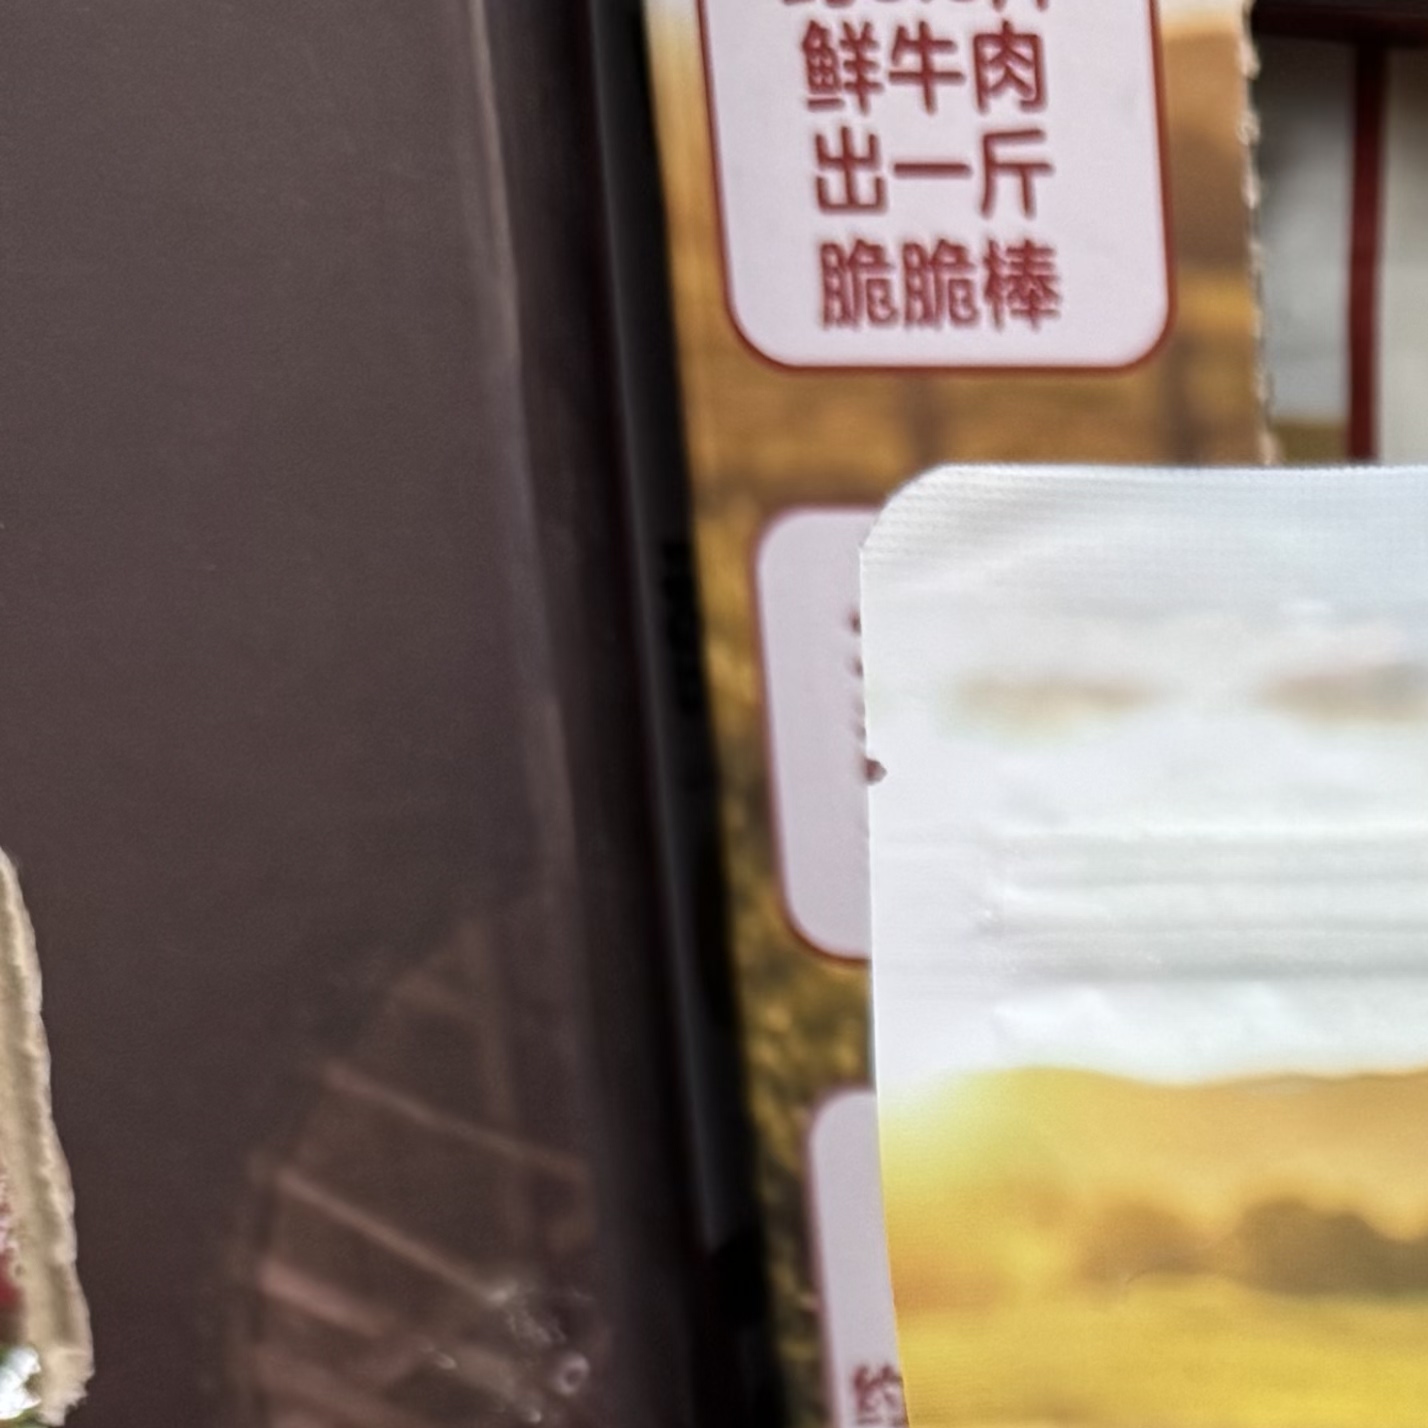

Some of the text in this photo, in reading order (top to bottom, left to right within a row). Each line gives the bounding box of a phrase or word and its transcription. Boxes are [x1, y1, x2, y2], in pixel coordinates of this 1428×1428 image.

[801, 20, 1046, 113] 鲜牛肉
[815, 126, 1052, 218] 出一斤
[819, 238, 1062, 330] 脆脆棒
